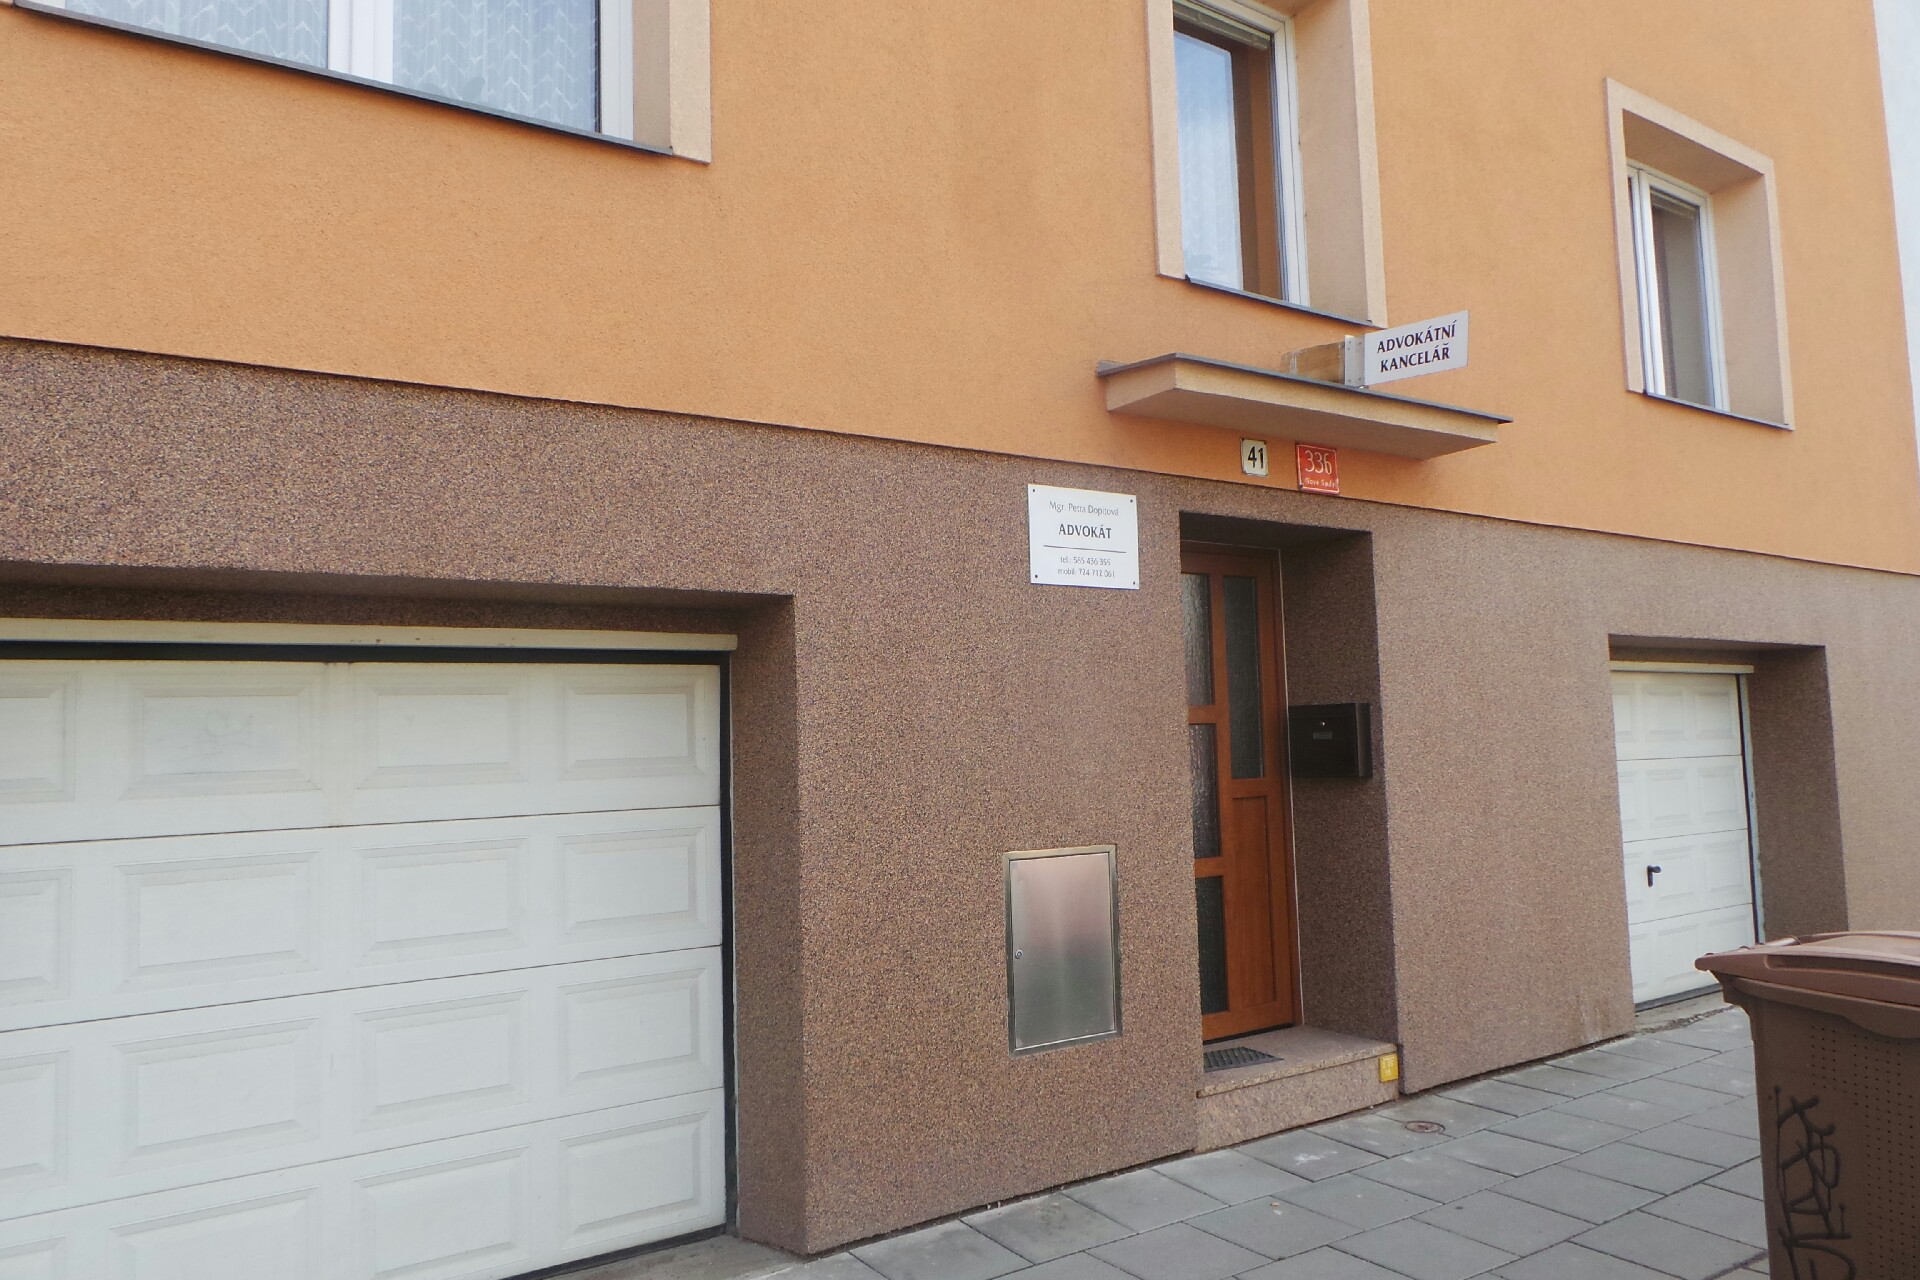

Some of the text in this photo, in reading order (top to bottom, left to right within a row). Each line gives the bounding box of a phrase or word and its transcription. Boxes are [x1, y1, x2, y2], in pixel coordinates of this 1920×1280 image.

[1377, 319, 1457, 353] ADVOKÁTNÍ
[1380, 341, 1450, 373] KANCELÁŘ
[1247, 446, 1264, 469] 41
[1304, 449, 1332, 475] 336
[1068, 502, 1086, 513] Petra
[1058, 523, 1112, 539] ADVOKÁT
[1078, 568, 1090, 576] 724
[1091, 569, 1103, 577] 712
